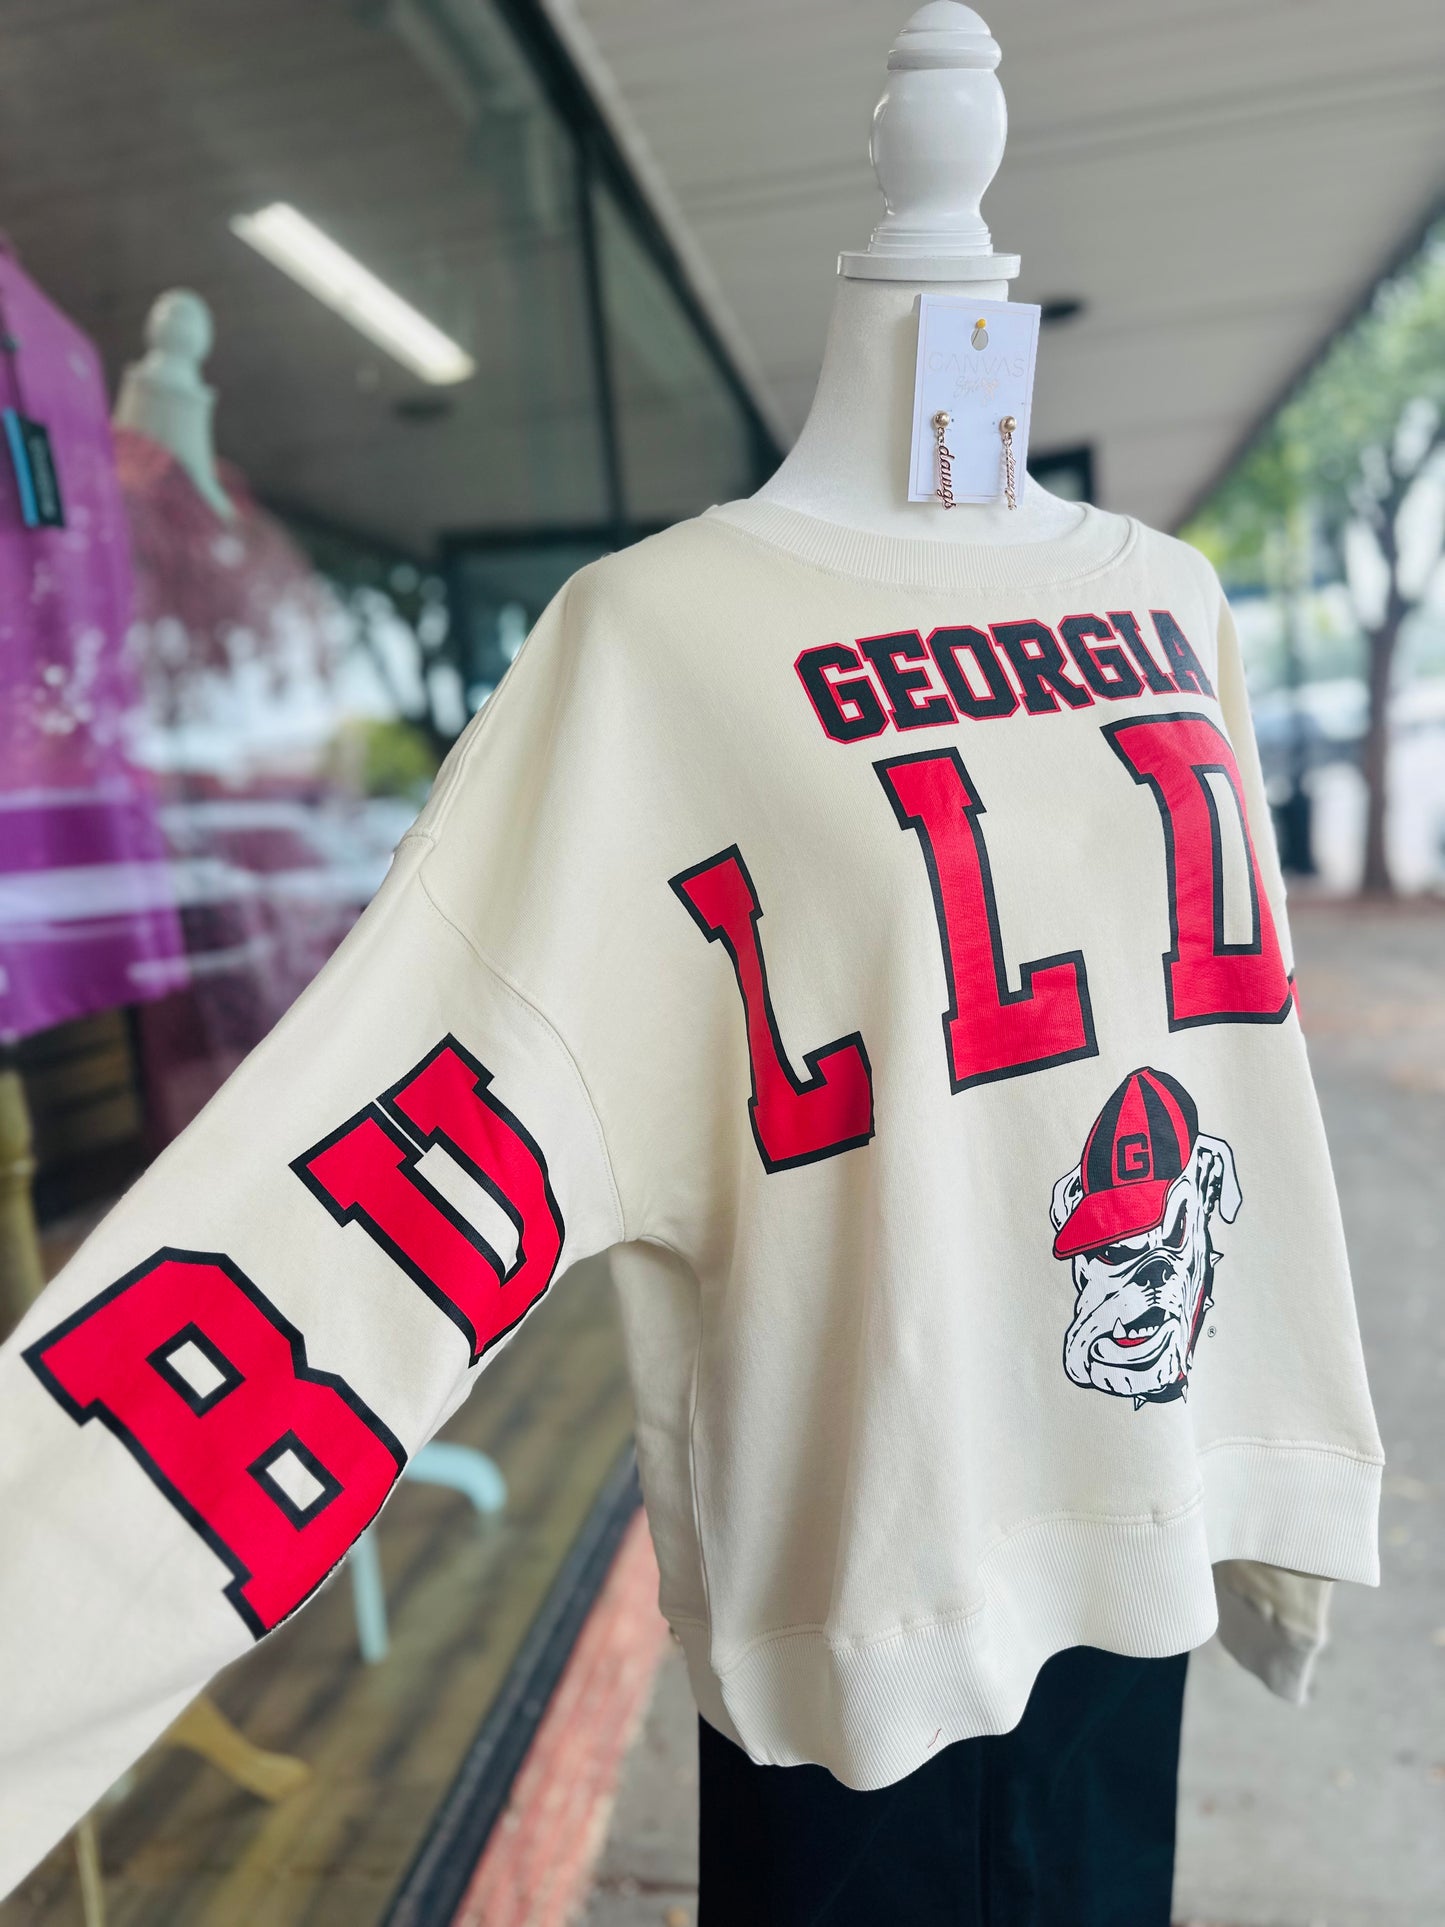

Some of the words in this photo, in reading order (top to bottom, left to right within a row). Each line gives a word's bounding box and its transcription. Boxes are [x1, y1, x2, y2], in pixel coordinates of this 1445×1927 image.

[928, 351, 1025, 378] CANVAS
[794, 610, 1217, 744] GEORGIA
[1116, 1132, 1150, 1182] G
